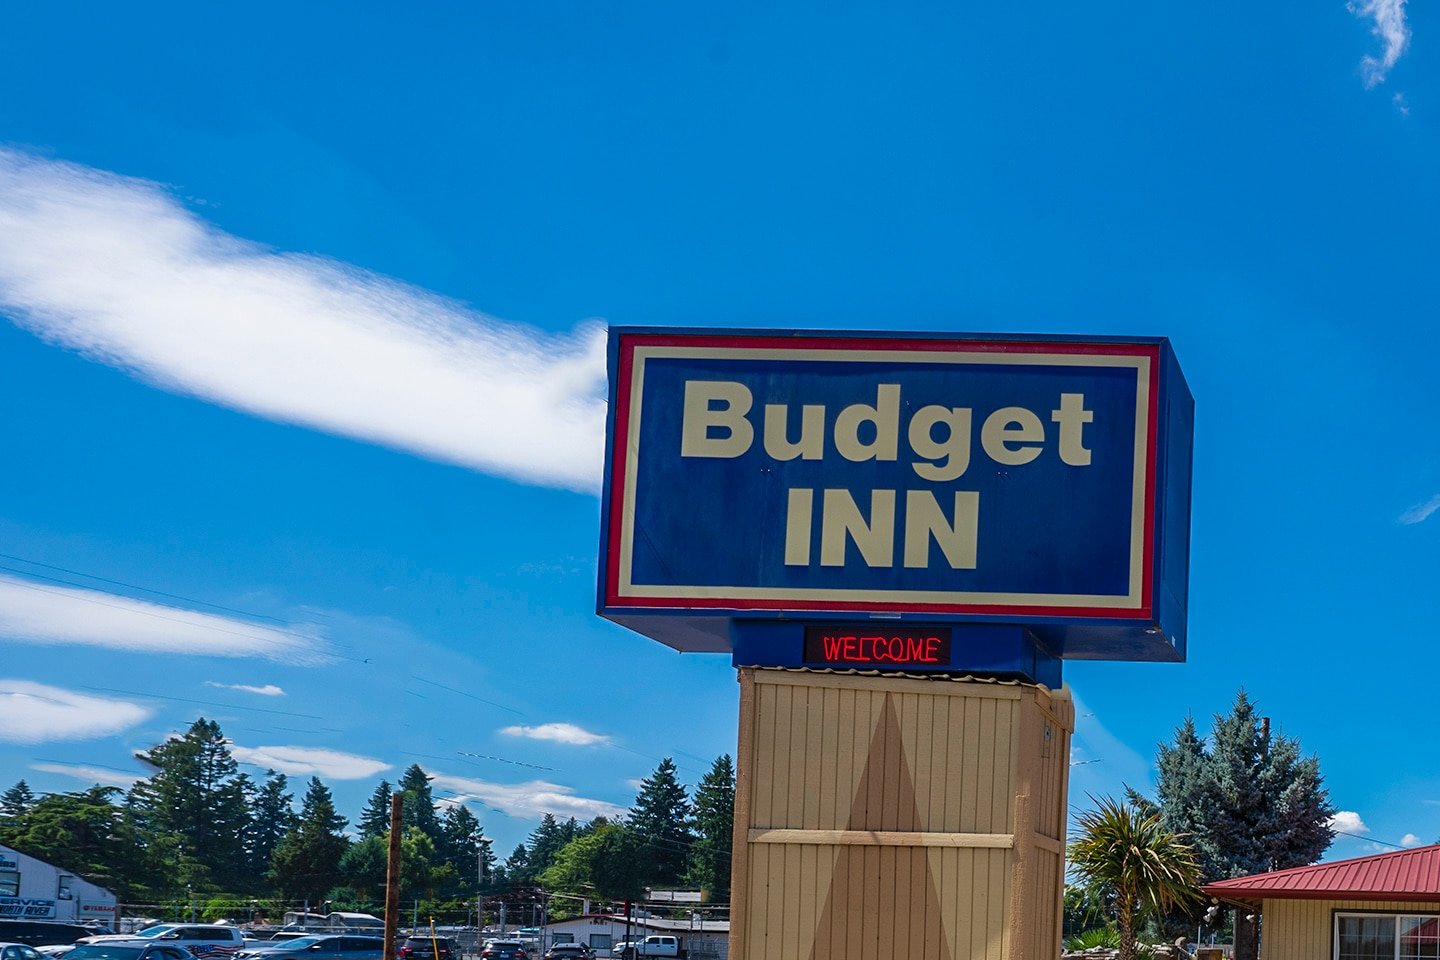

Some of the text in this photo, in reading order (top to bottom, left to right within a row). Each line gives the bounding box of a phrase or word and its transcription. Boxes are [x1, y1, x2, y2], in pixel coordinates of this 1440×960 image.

[681, 380, 1093, 481] Budget
[784, 488, 980, 569] INN
[823, 637, 941, 661] WELCOME
